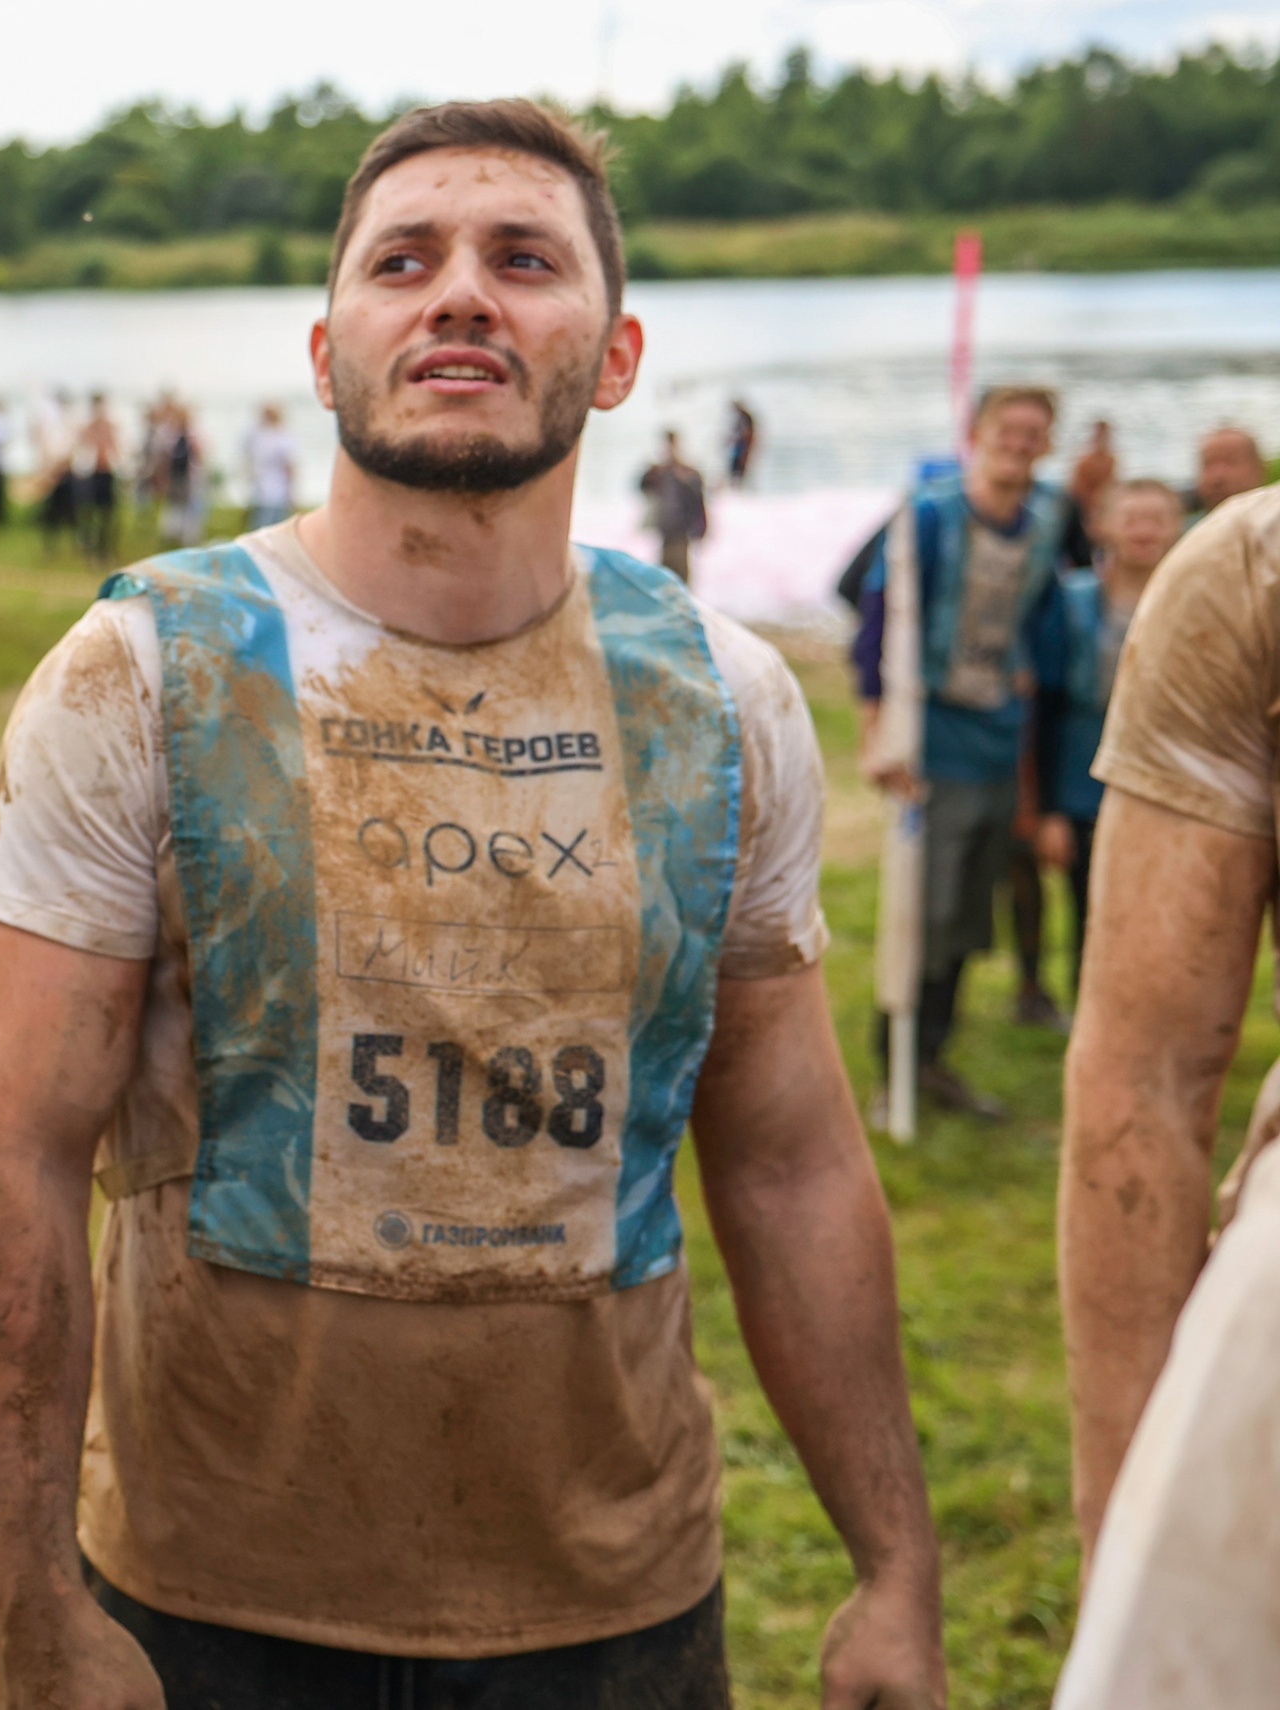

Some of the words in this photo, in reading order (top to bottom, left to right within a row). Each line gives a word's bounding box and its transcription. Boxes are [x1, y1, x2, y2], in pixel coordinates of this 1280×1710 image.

[320, 717, 451, 752] ГОНКА
[461, 730, 602, 765] ГЕРОЕВ
[357, 817, 593, 887] apex
[347, 1033, 606, 1149] 5188
